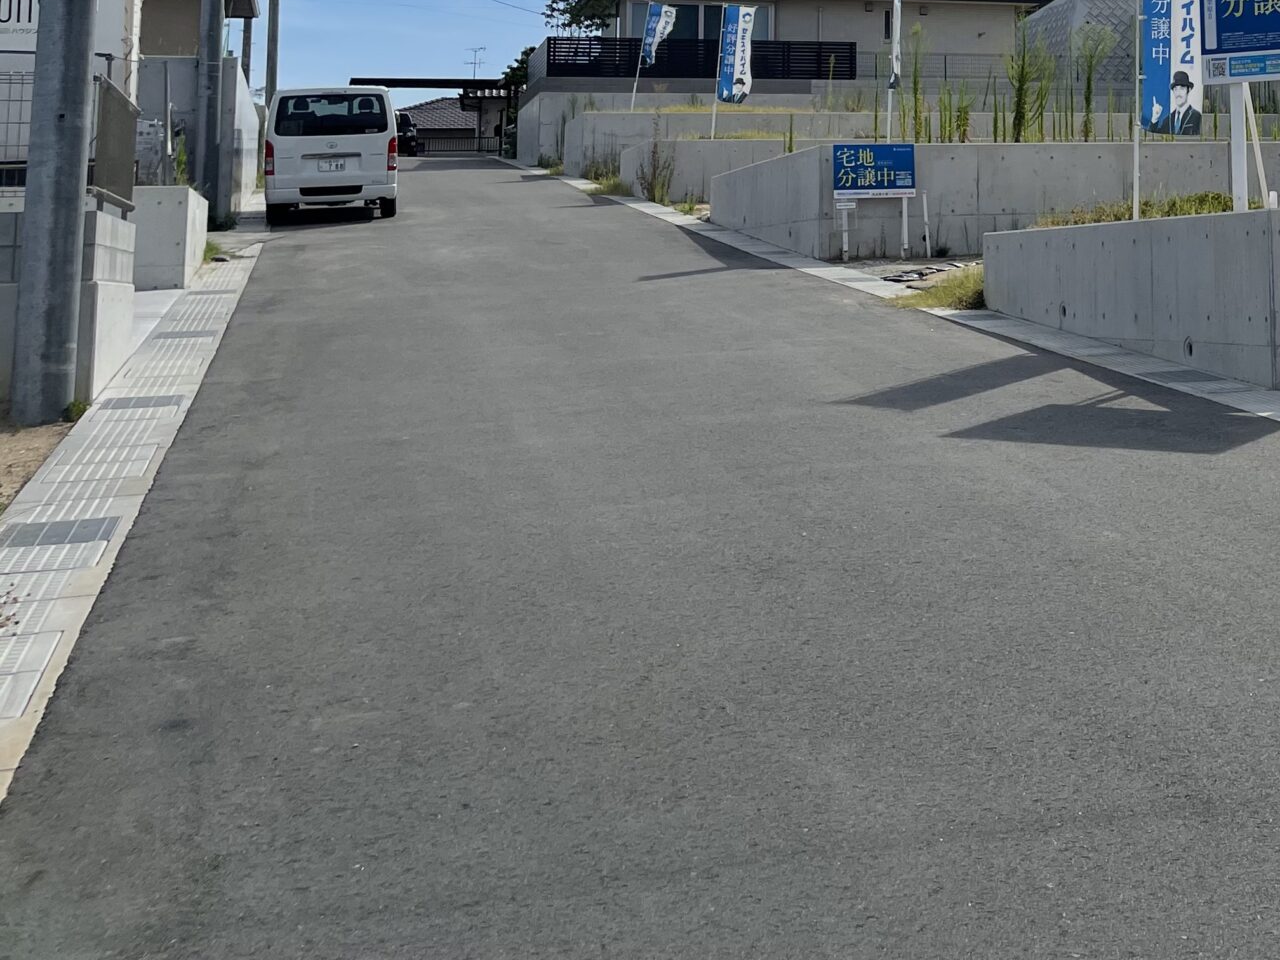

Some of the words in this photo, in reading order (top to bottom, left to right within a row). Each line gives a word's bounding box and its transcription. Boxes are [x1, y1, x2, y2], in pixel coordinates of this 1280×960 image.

[836, 147, 875, 167] 宅地
[837, 167, 895, 187] 分譲中
